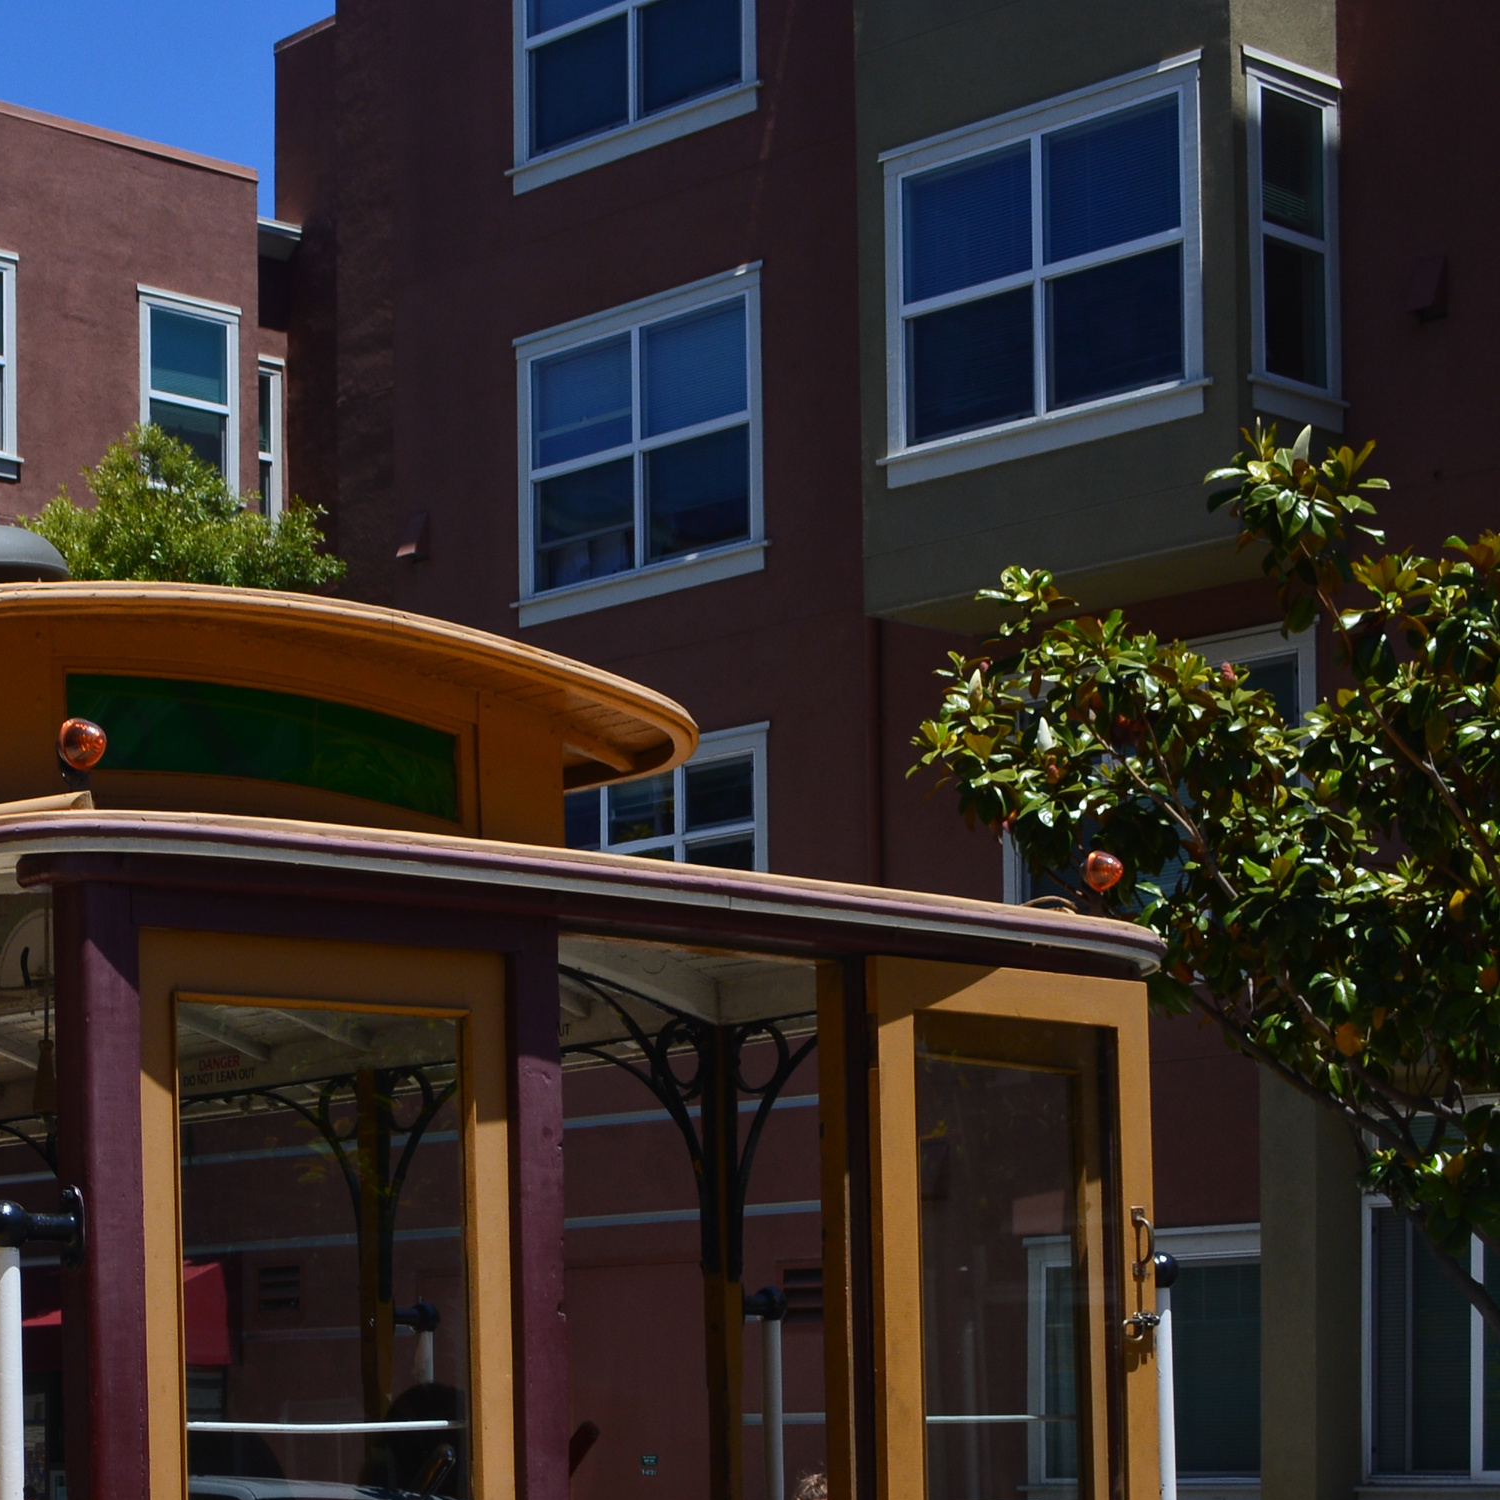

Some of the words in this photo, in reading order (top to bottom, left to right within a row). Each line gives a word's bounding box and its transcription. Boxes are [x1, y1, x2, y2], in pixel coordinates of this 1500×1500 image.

[199, 1054, 240, 1071] DANGER
[183, 1075, 196, 1087] DO
[197, 1072, 213, 1085] NOT
[216, 1069, 237, 1083] LEAN
[238, 1067, 256, 1080] OUT
